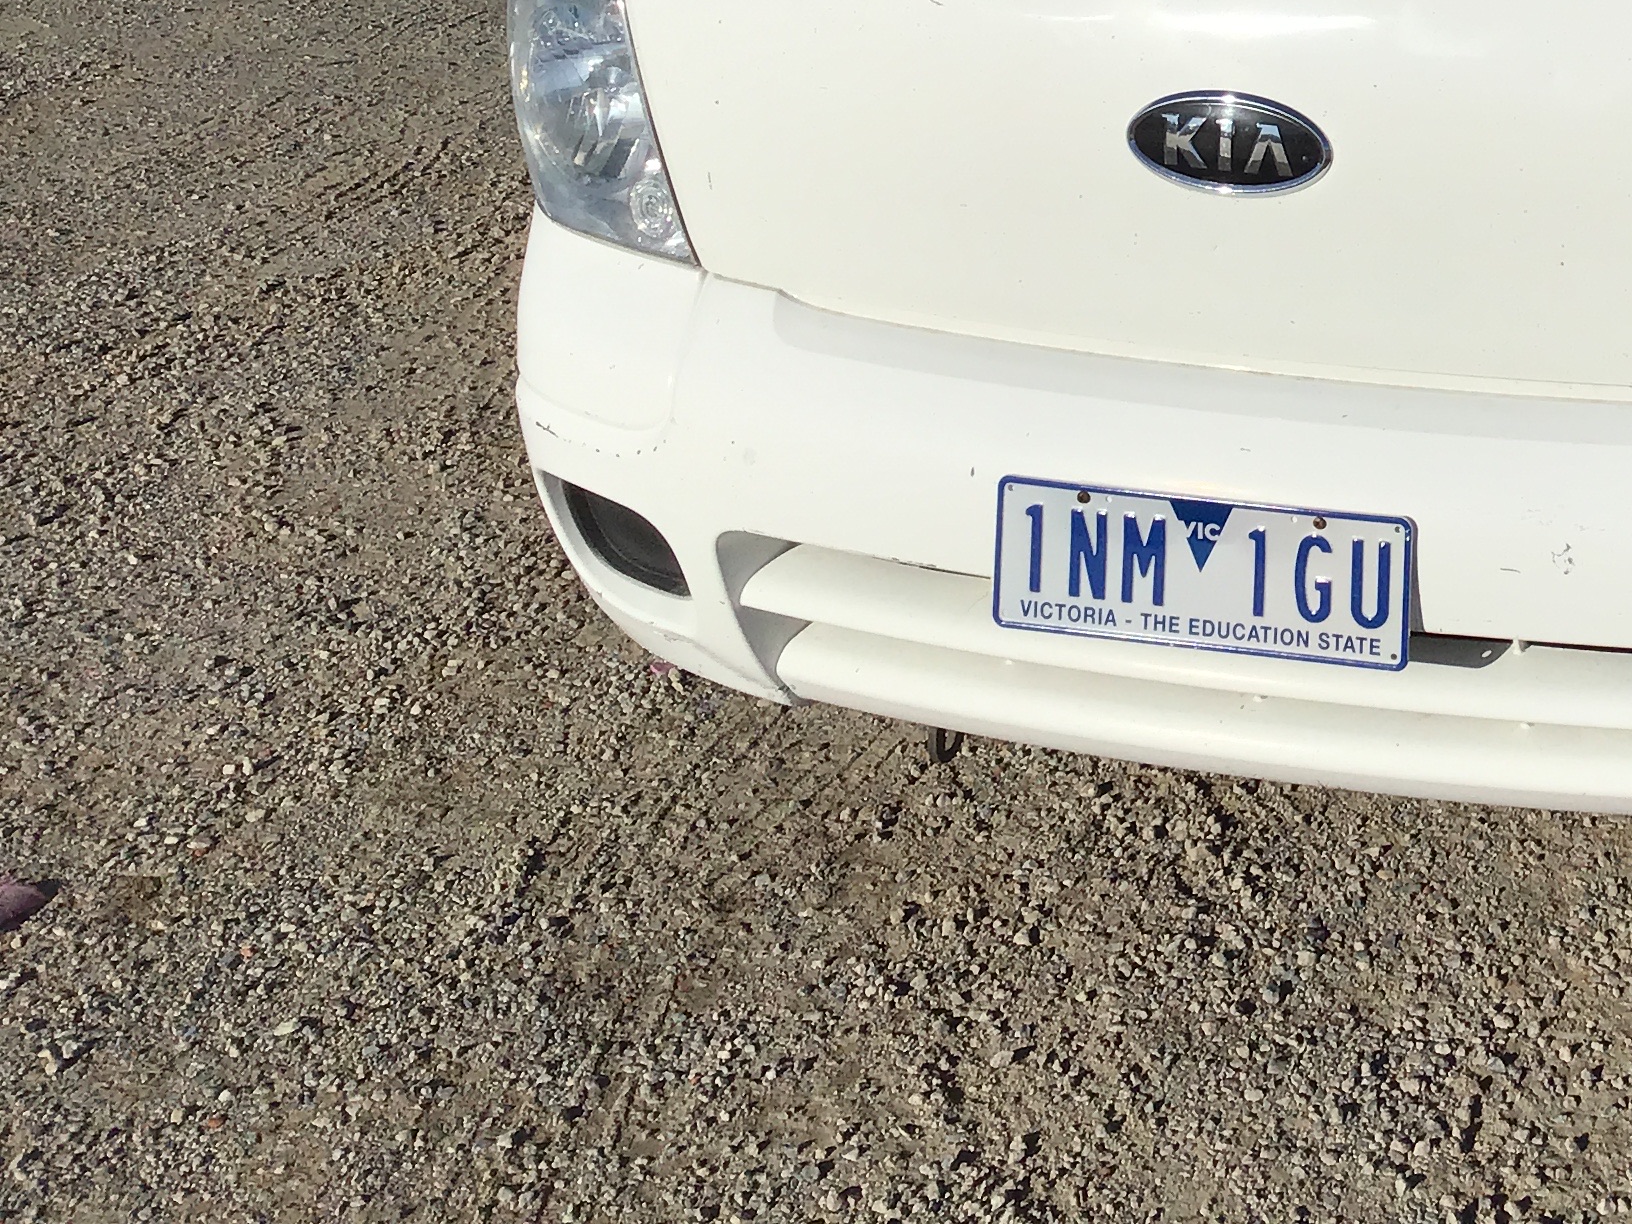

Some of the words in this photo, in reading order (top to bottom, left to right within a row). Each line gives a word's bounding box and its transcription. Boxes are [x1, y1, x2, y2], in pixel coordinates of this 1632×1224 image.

[1162, 113, 1294, 177] KIA
[1182, 520, 1222, 542] VIC
[1025, 504, 1167, 607] 1NM
[1248, 525, 1392, 629] 1GU
[1020, 599, 1117, 627] VICTORIA
[1140, 613, 1181, 634] THE
[1189, 618, 1310, 648] EDUCATION
[1318, 633, 1382, 657] STATE
